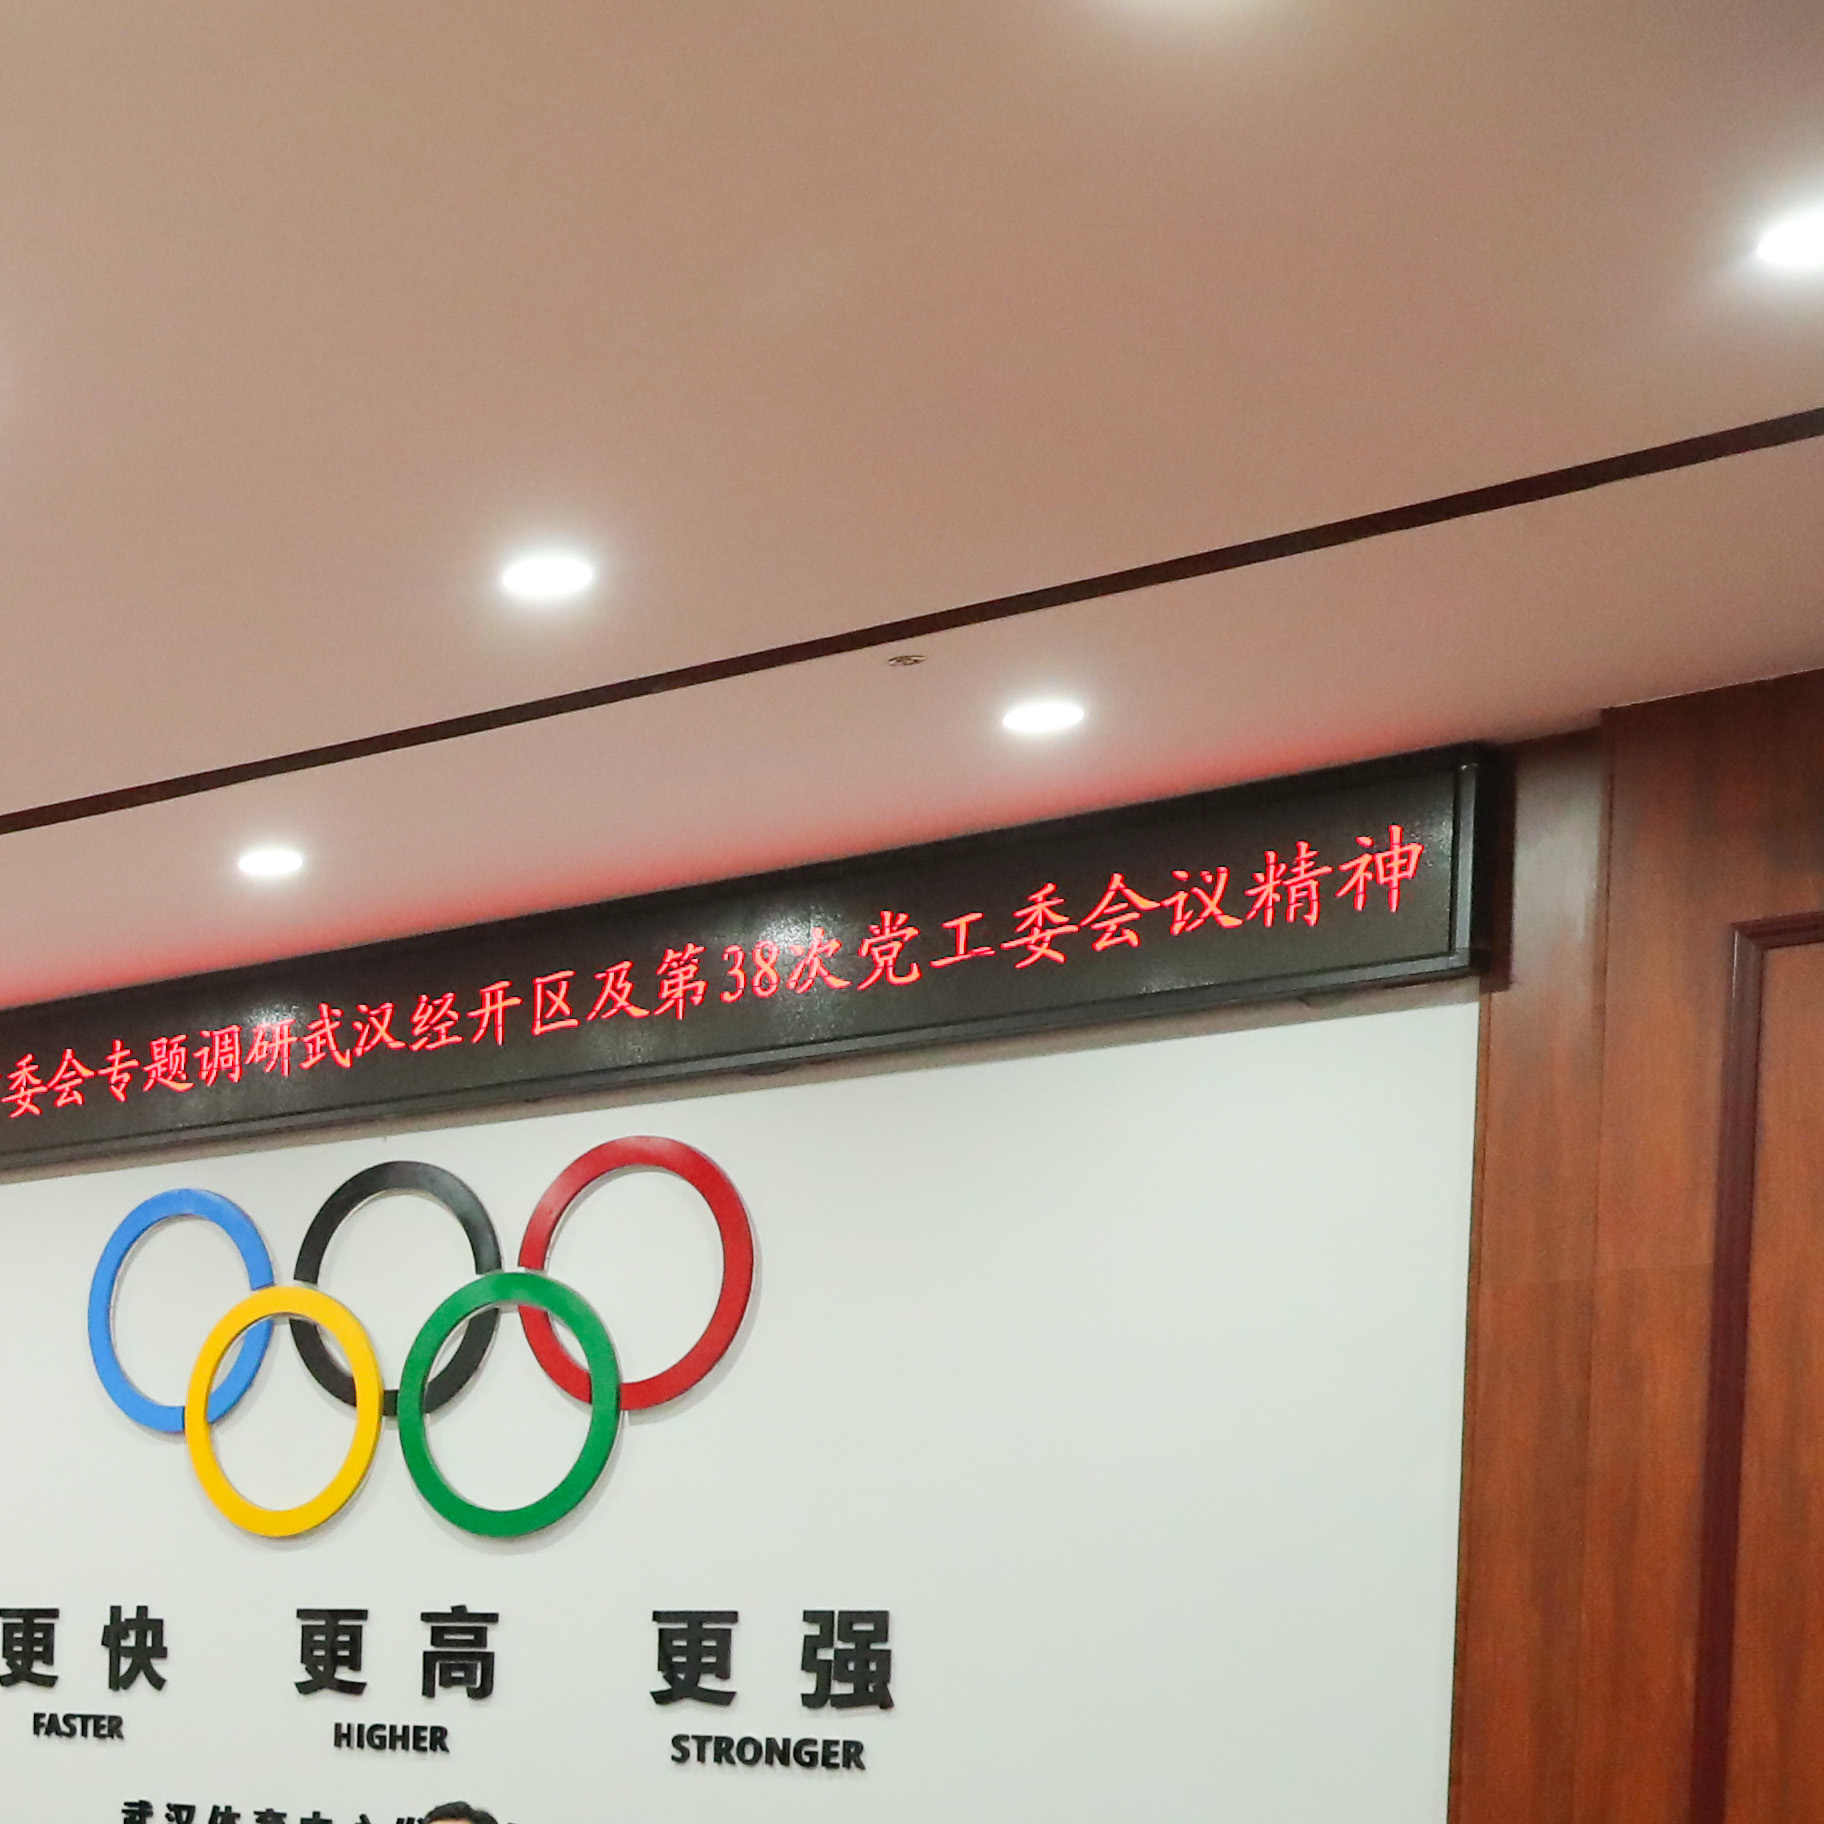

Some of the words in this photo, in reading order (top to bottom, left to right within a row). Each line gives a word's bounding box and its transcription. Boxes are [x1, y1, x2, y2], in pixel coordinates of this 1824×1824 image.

[295, 1604, 498, 1700] 更高
[650, 1609, 895, 1711] 更强
[33, 1712, 124, 1740] FASTER
[333, 1722, 450, 1753] HIGHER
[670, 1734, 866, 1771] STRONGER
